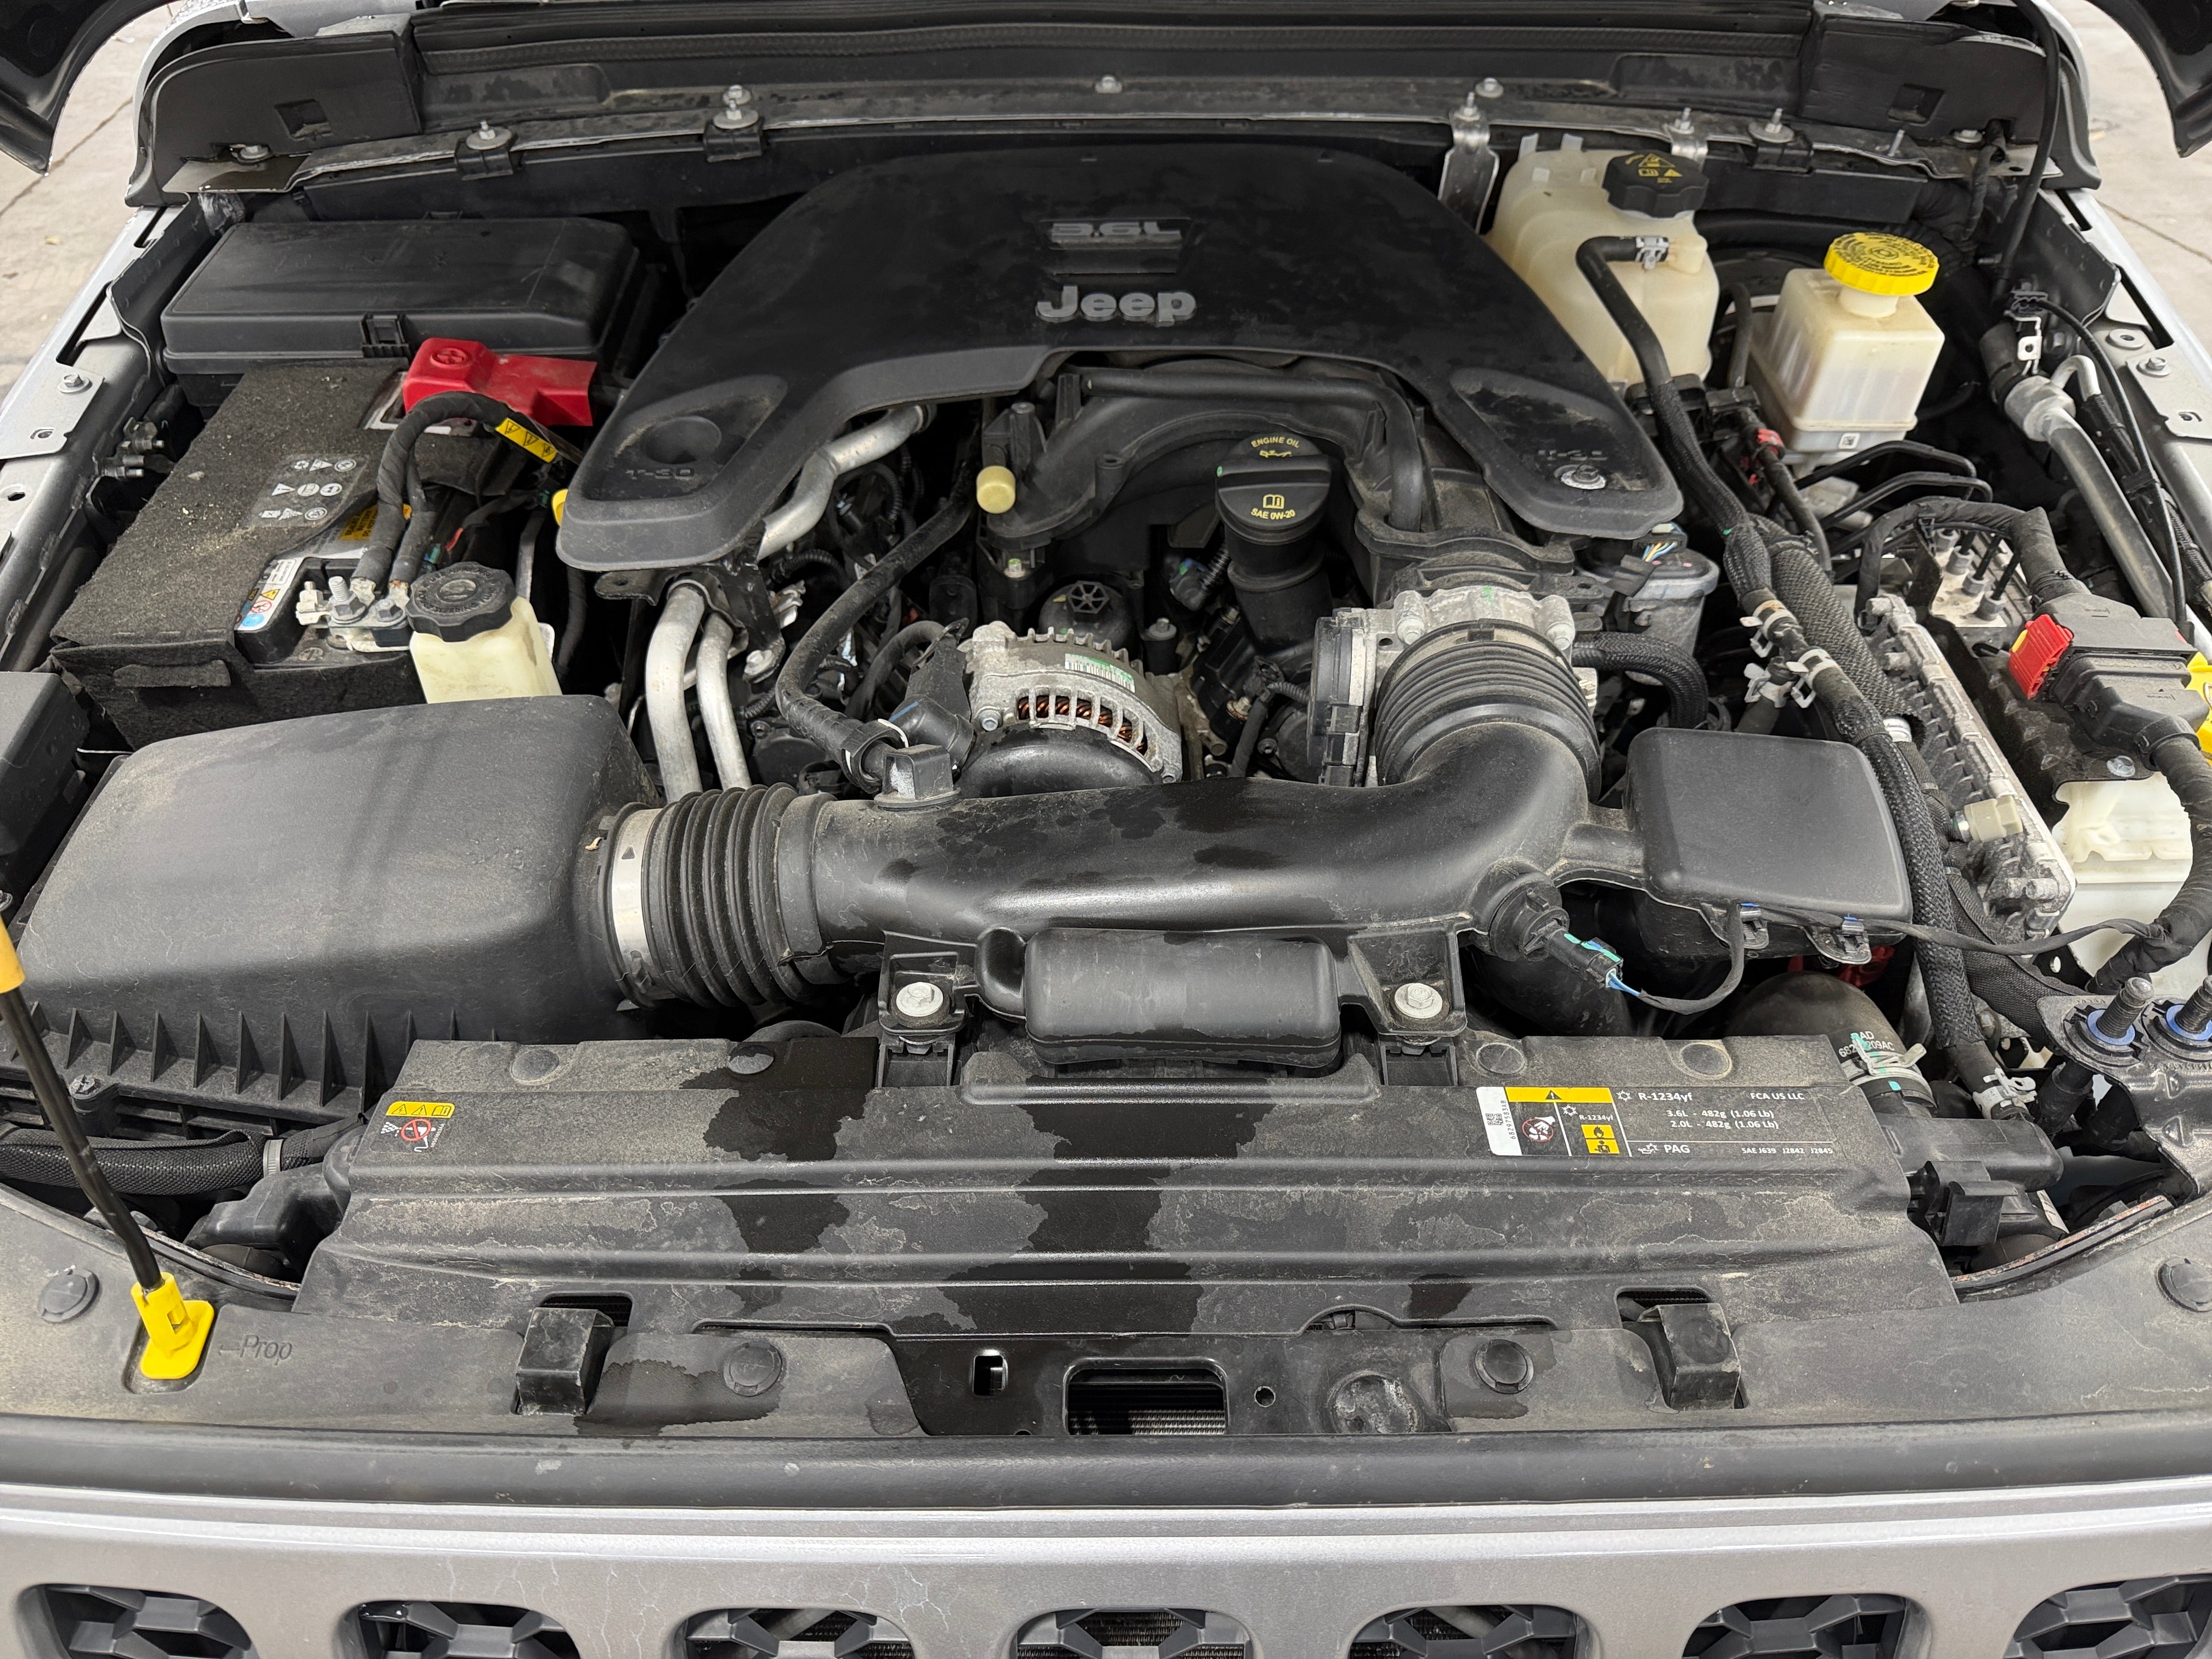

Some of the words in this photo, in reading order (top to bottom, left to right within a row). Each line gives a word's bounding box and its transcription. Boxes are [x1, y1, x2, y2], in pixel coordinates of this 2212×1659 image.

[1036, 285, 1197, 327] Jeep
[1251, 437, 1285, 448] ENGINE
[1286, 438, 1299, 448] OIL
[1251, 508, 1268, 520] SAE
[1270, 510, 1296, 520] 0W-20
[1839, 1040, 1895, 1058] 682209AC
[1638, 1092, 1692, 1102] R-1234yf
[1500, 1100, 1516, 1139] 68297583AB
[1701, 1110, 1727, 1119] 482g
[1730, 1110, 1756, 1119] (1.06
[1757, 1110, 1774, 1119] Lb)
[1706, 1120, 1731, 1130] 482g
[1734, 1120, 1760, 1130] (1.06
[1763, 1120, 1779, 1130] Lb)
[1663, 1144, 1690, 1153] PAG
[240, 1335, 292, 1365] Prop
